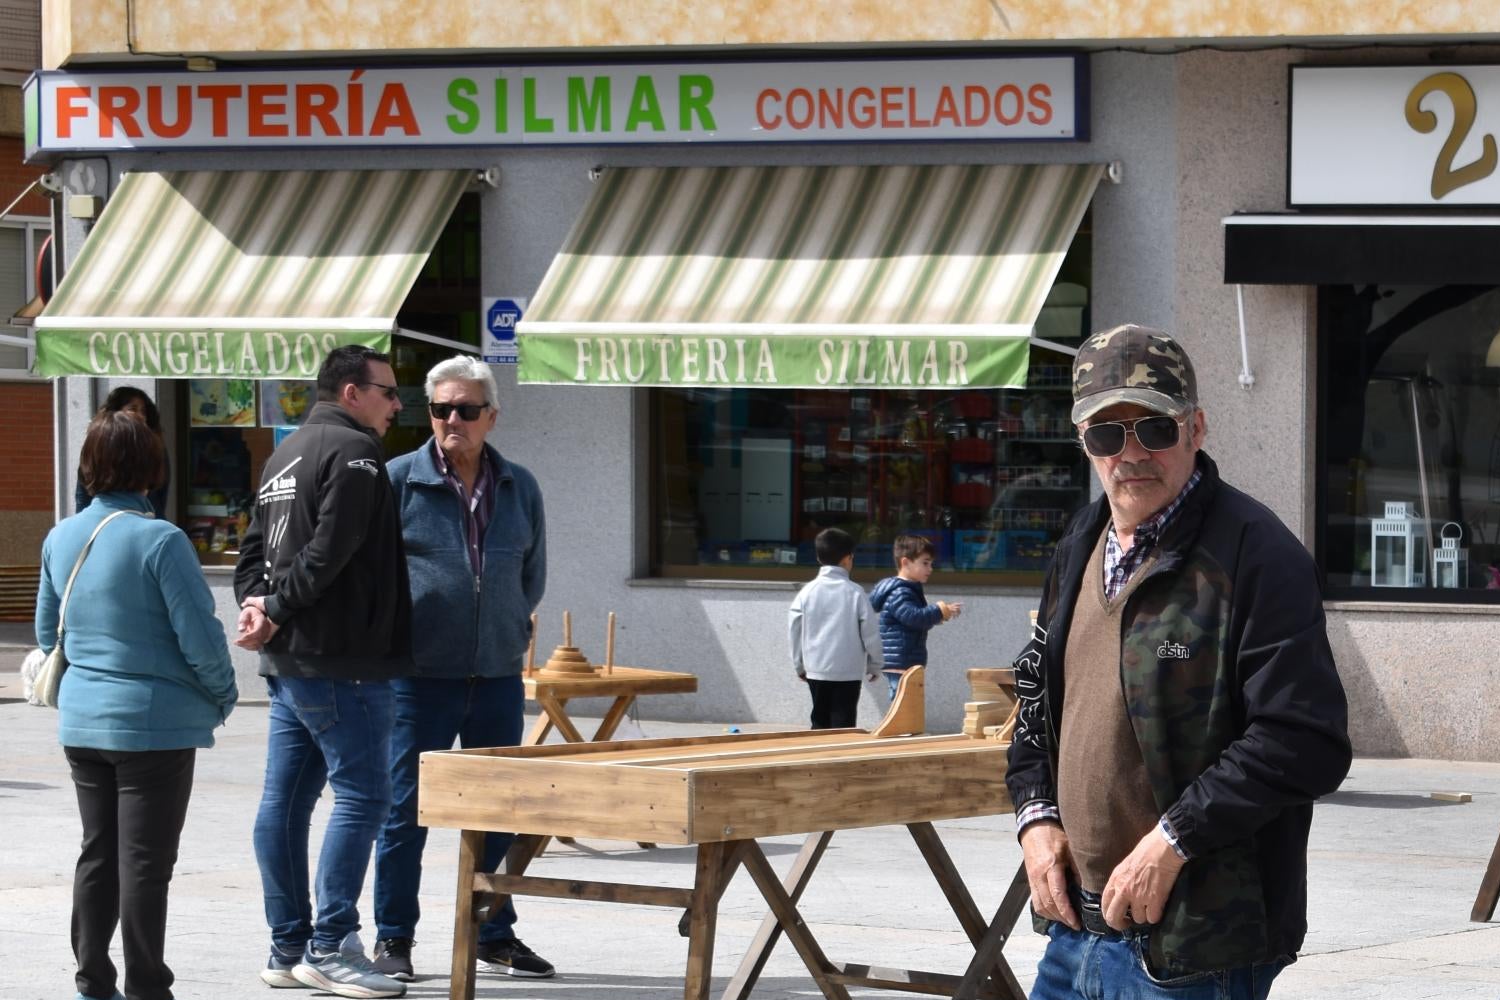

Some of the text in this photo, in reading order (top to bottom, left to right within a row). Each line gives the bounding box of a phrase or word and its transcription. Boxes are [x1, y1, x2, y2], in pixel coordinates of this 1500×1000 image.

[56, 69, 718, 139] FRUTERÍA SILMAR
[754, 83, 1054, 132] CONGELADOS
[1404, 71, 1498, 200] 2
[493, 312, 518, 328] ADT
[573, 337, 969, 386] FRUTERIA SILMAR
